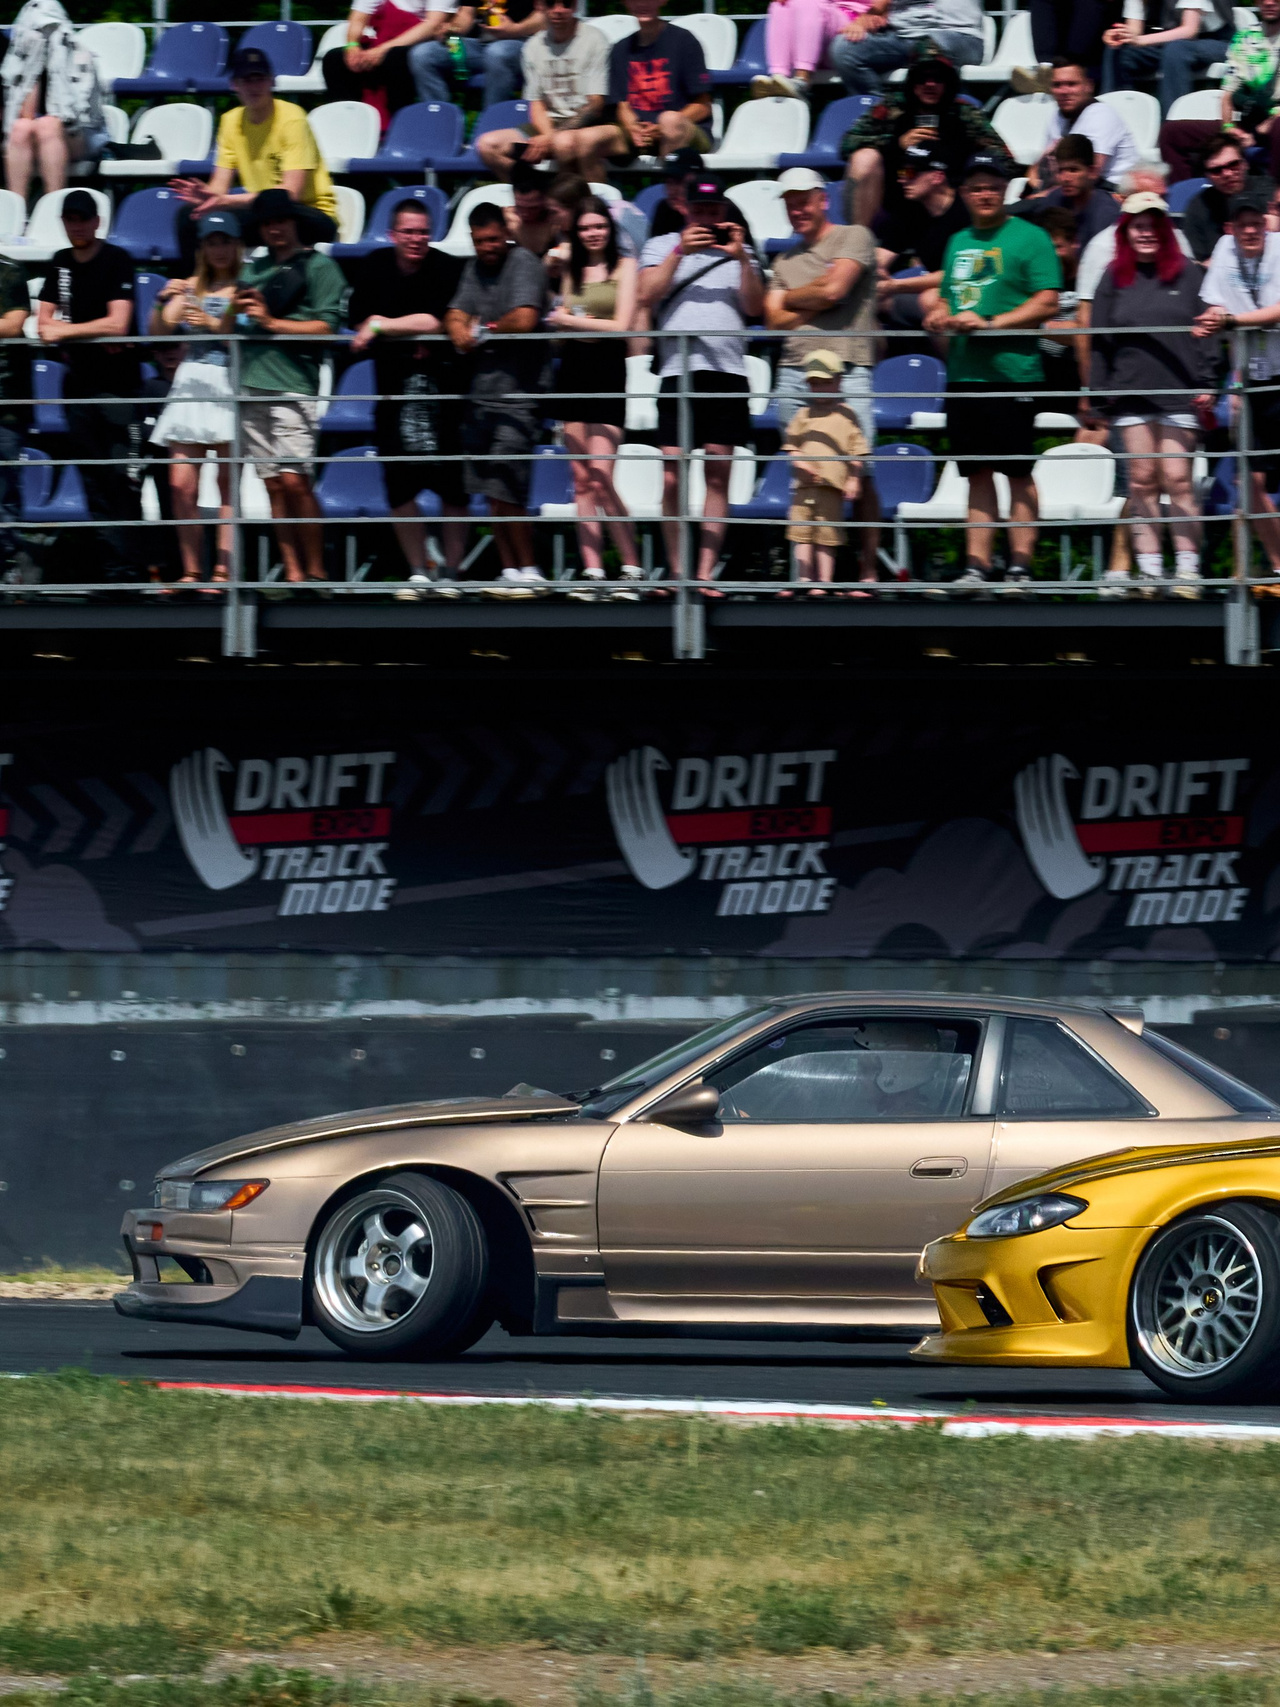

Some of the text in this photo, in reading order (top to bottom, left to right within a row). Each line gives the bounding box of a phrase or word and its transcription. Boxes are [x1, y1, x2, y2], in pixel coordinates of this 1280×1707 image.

[234, 752, 397, 811] DRIFT
[671, 750, 838, 810] DRIFT
[1080, 758, 1250, 819] DRIFT
